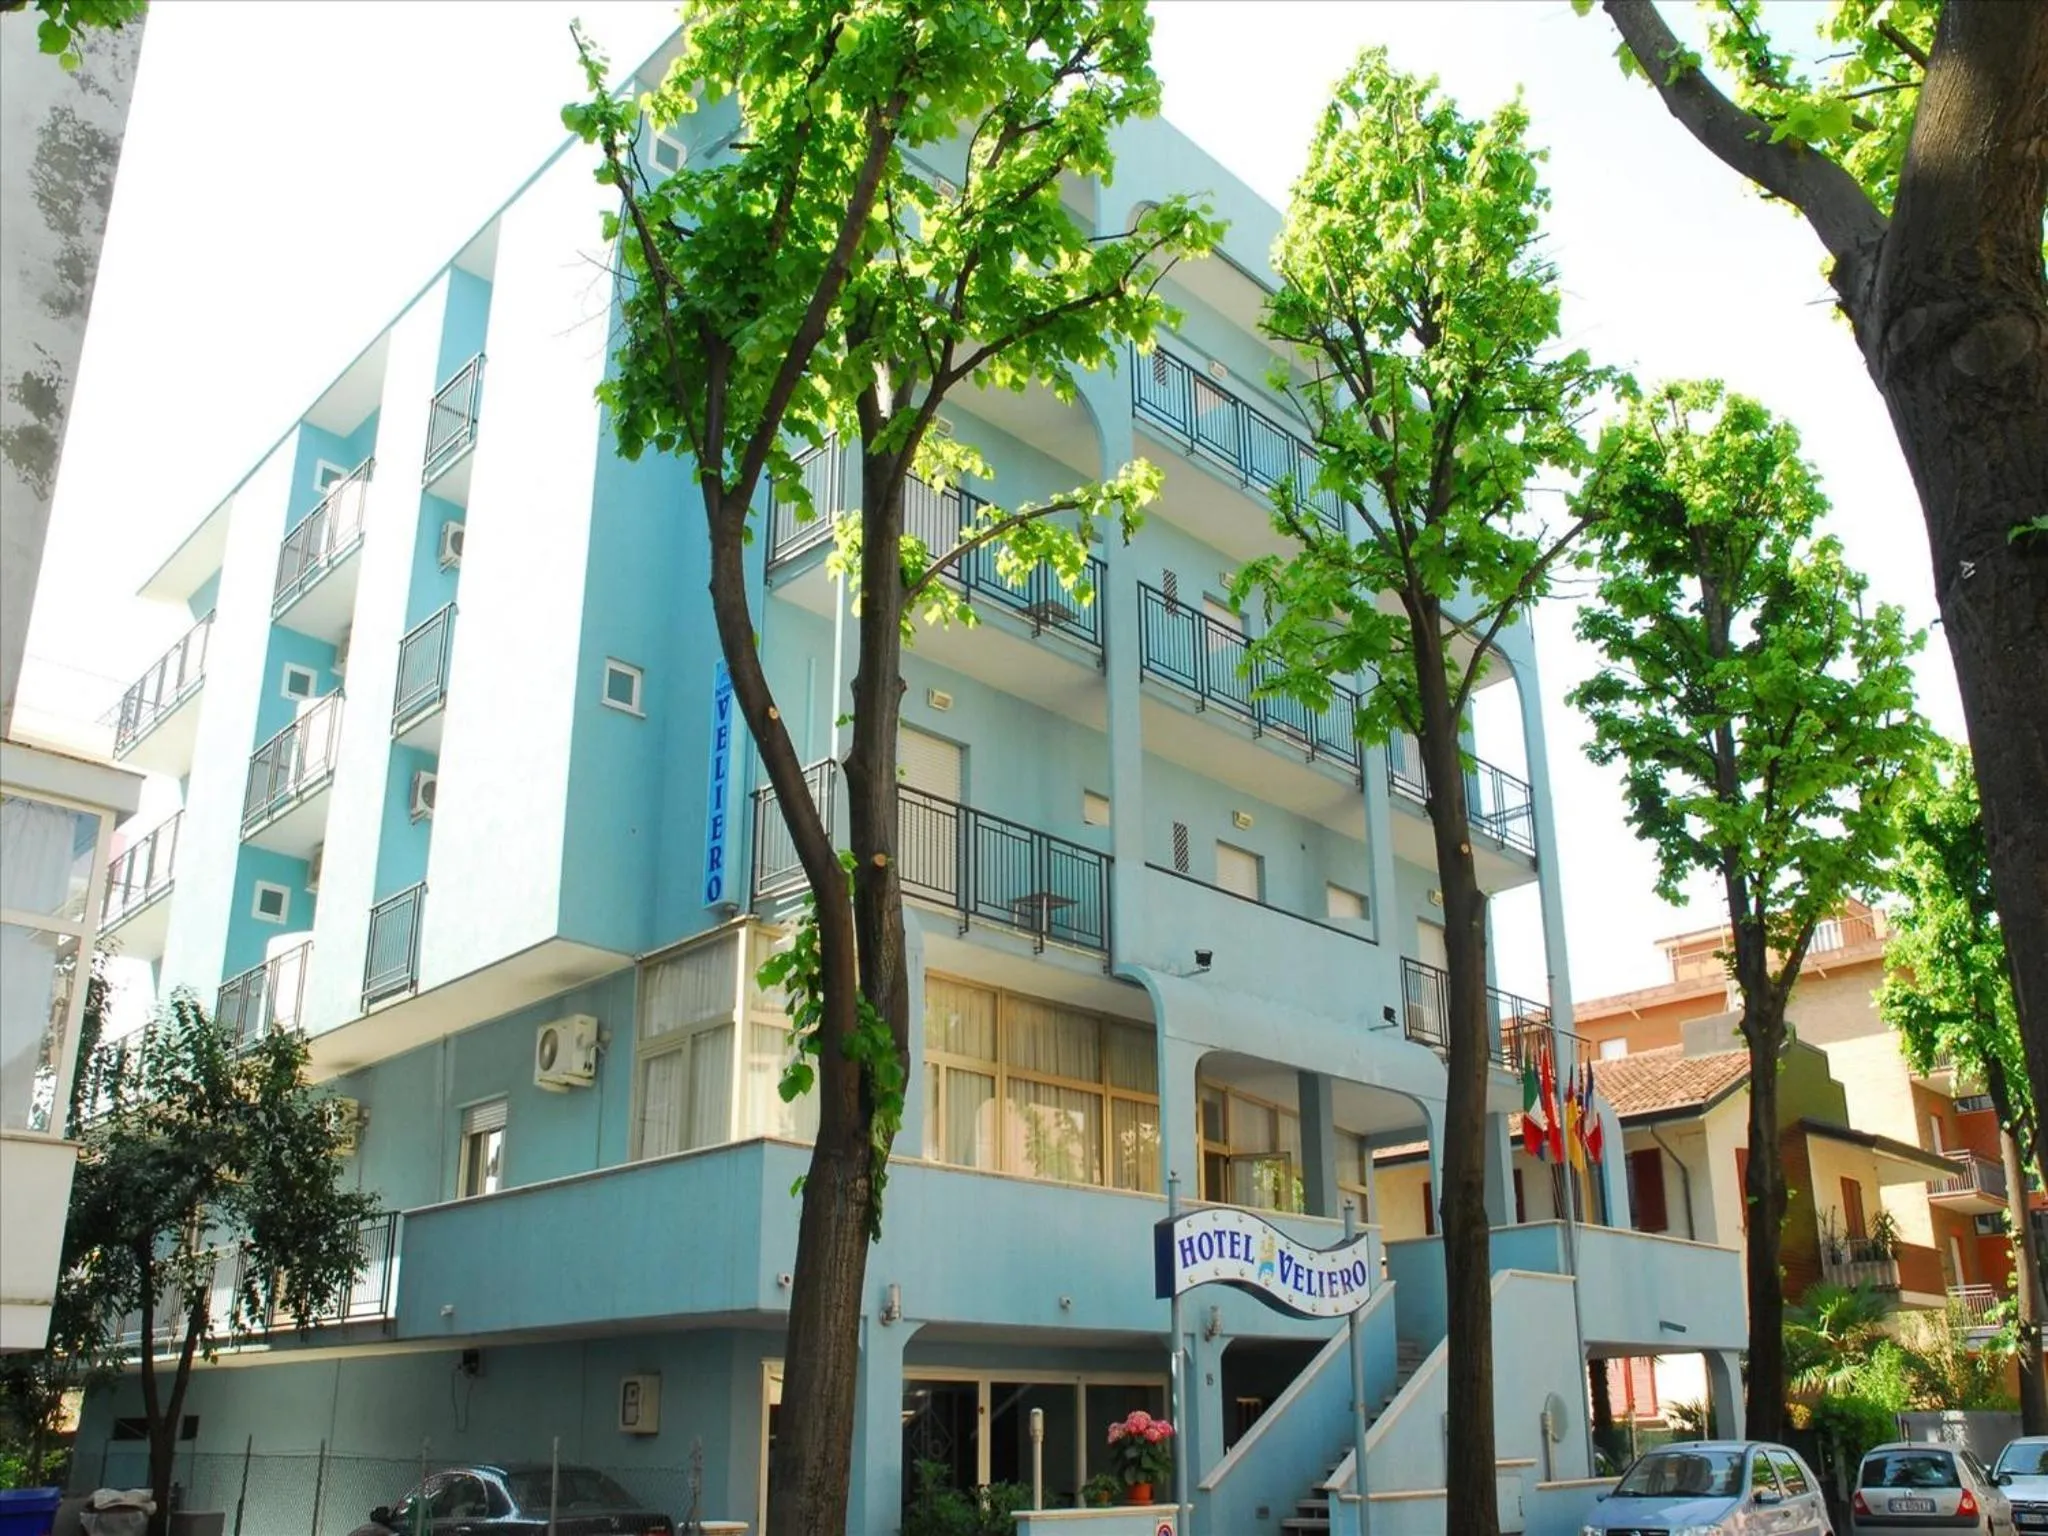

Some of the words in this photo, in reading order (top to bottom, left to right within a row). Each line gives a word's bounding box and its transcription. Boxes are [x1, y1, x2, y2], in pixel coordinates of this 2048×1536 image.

[707, 694, 731, 902] VELIERO
[1178, 1229, 1255, 1269] HOTEL
[1278, 1249, 1367, 1298] VELIERO
